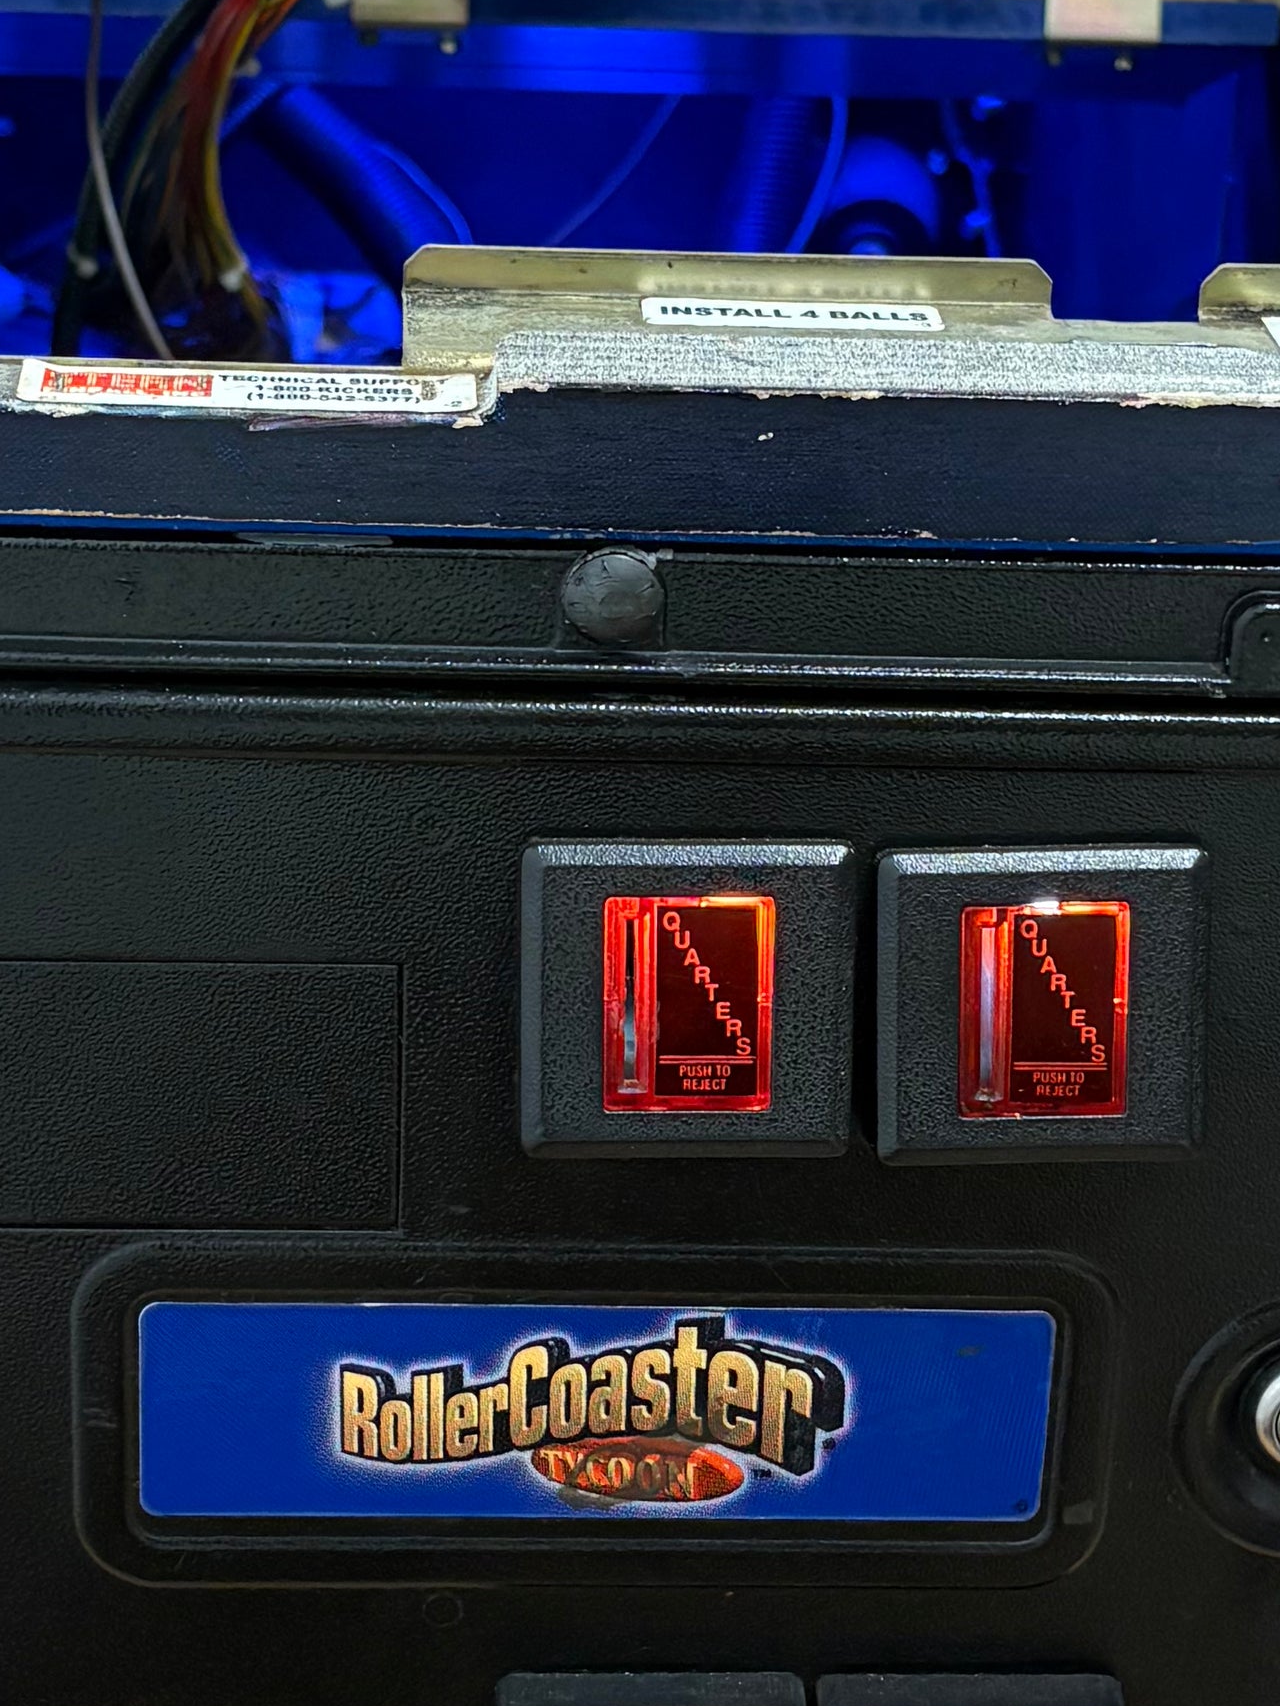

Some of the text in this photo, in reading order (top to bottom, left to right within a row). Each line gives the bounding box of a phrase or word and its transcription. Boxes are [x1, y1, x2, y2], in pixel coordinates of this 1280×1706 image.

[660, 305, 929, 322] INSTALL 4 BALLS
[218, 374, 342, 385] TECHNICAL
[662, 911, 751, 1055] QUARTERS
[1020, 919, 1105, 1063] QUARTERS
[679, 1064, 731, 1077] PUSH TO
[1032, 1071, 1085, 1084] PUSH TO
[682, 1078, 726, 1091] REJECT
[1036, 1085, 1080, 1097] REJECT
[340, 1321, 830, 1473] RollerCoaster
[539, 1448, 700, 1500] TYCOON
